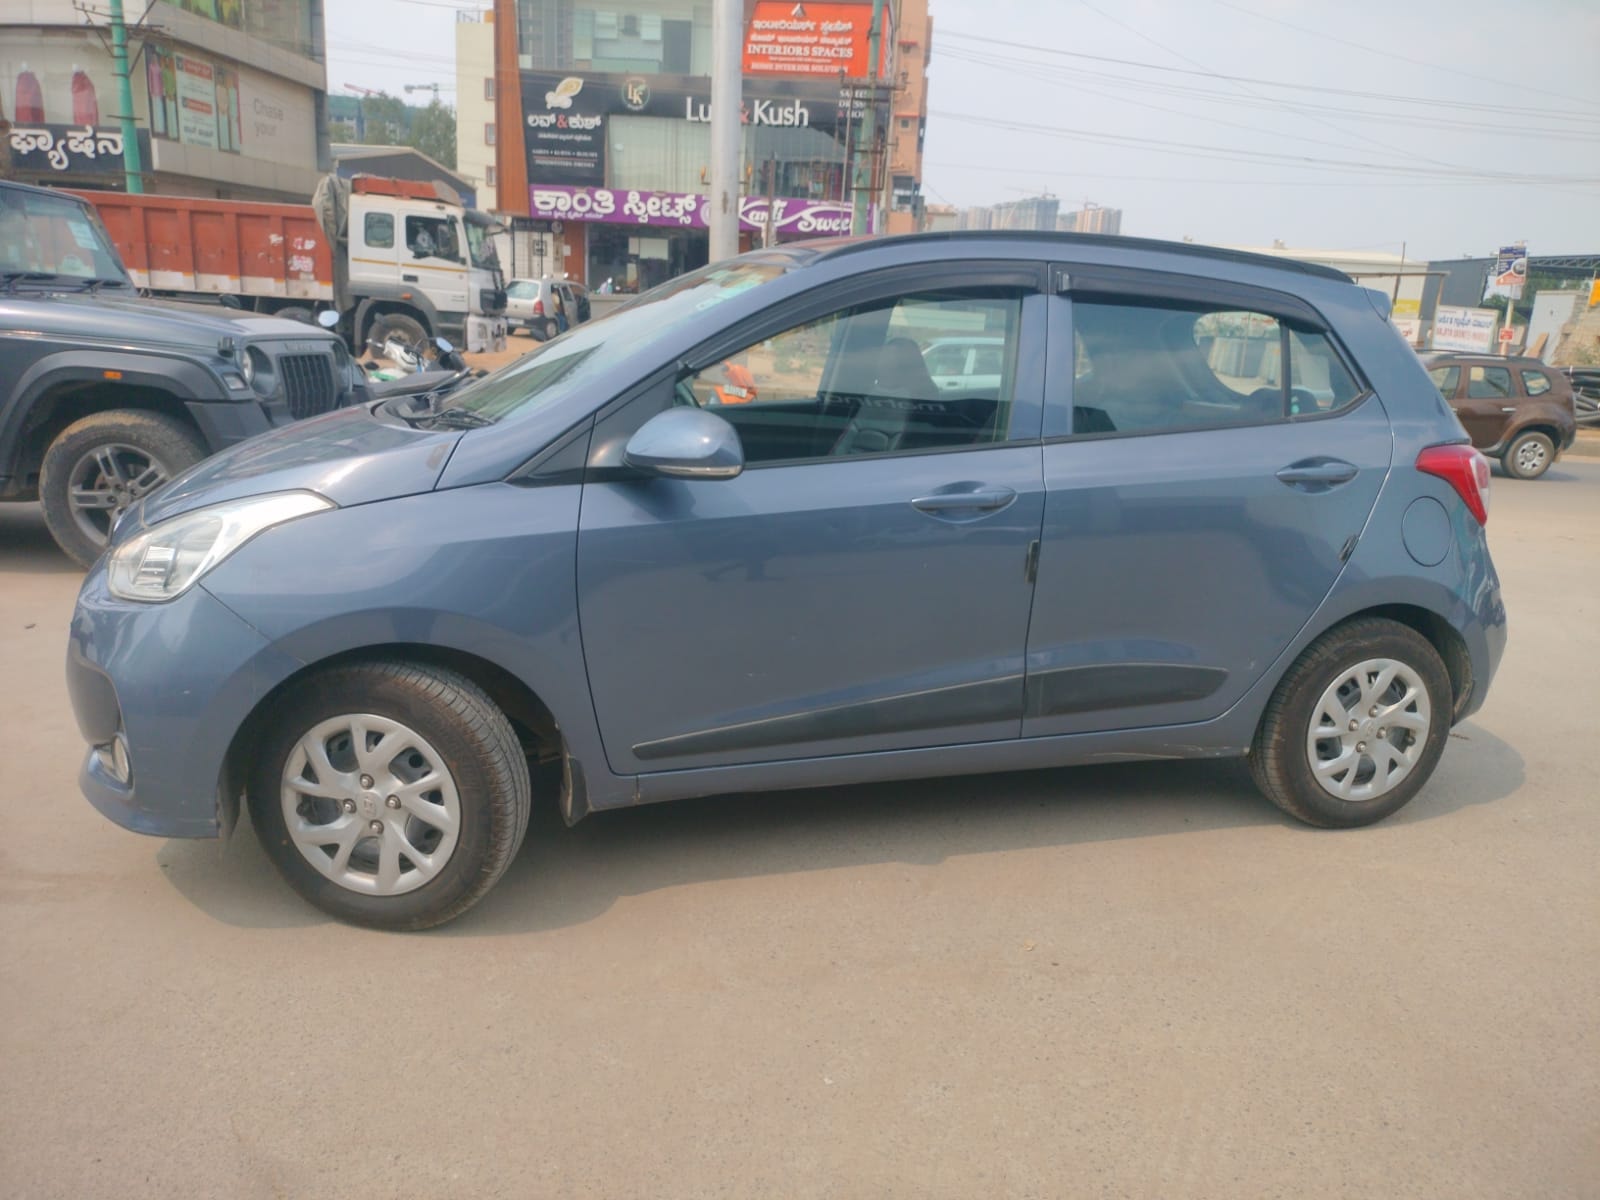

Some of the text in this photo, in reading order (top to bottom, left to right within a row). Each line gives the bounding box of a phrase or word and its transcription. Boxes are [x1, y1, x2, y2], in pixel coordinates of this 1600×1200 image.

[747, 44, 853, 58] INTERIORS SPACES
[254, 97, 284, 121] Chase
[686, 96, 712, 122] Lu
[753, 99, 809, 127] Kush
[254, 121, 277, 137] your
[556, 114, 568, 128] &
[533, 189, 615, 215] ಕಾಂತಿ
